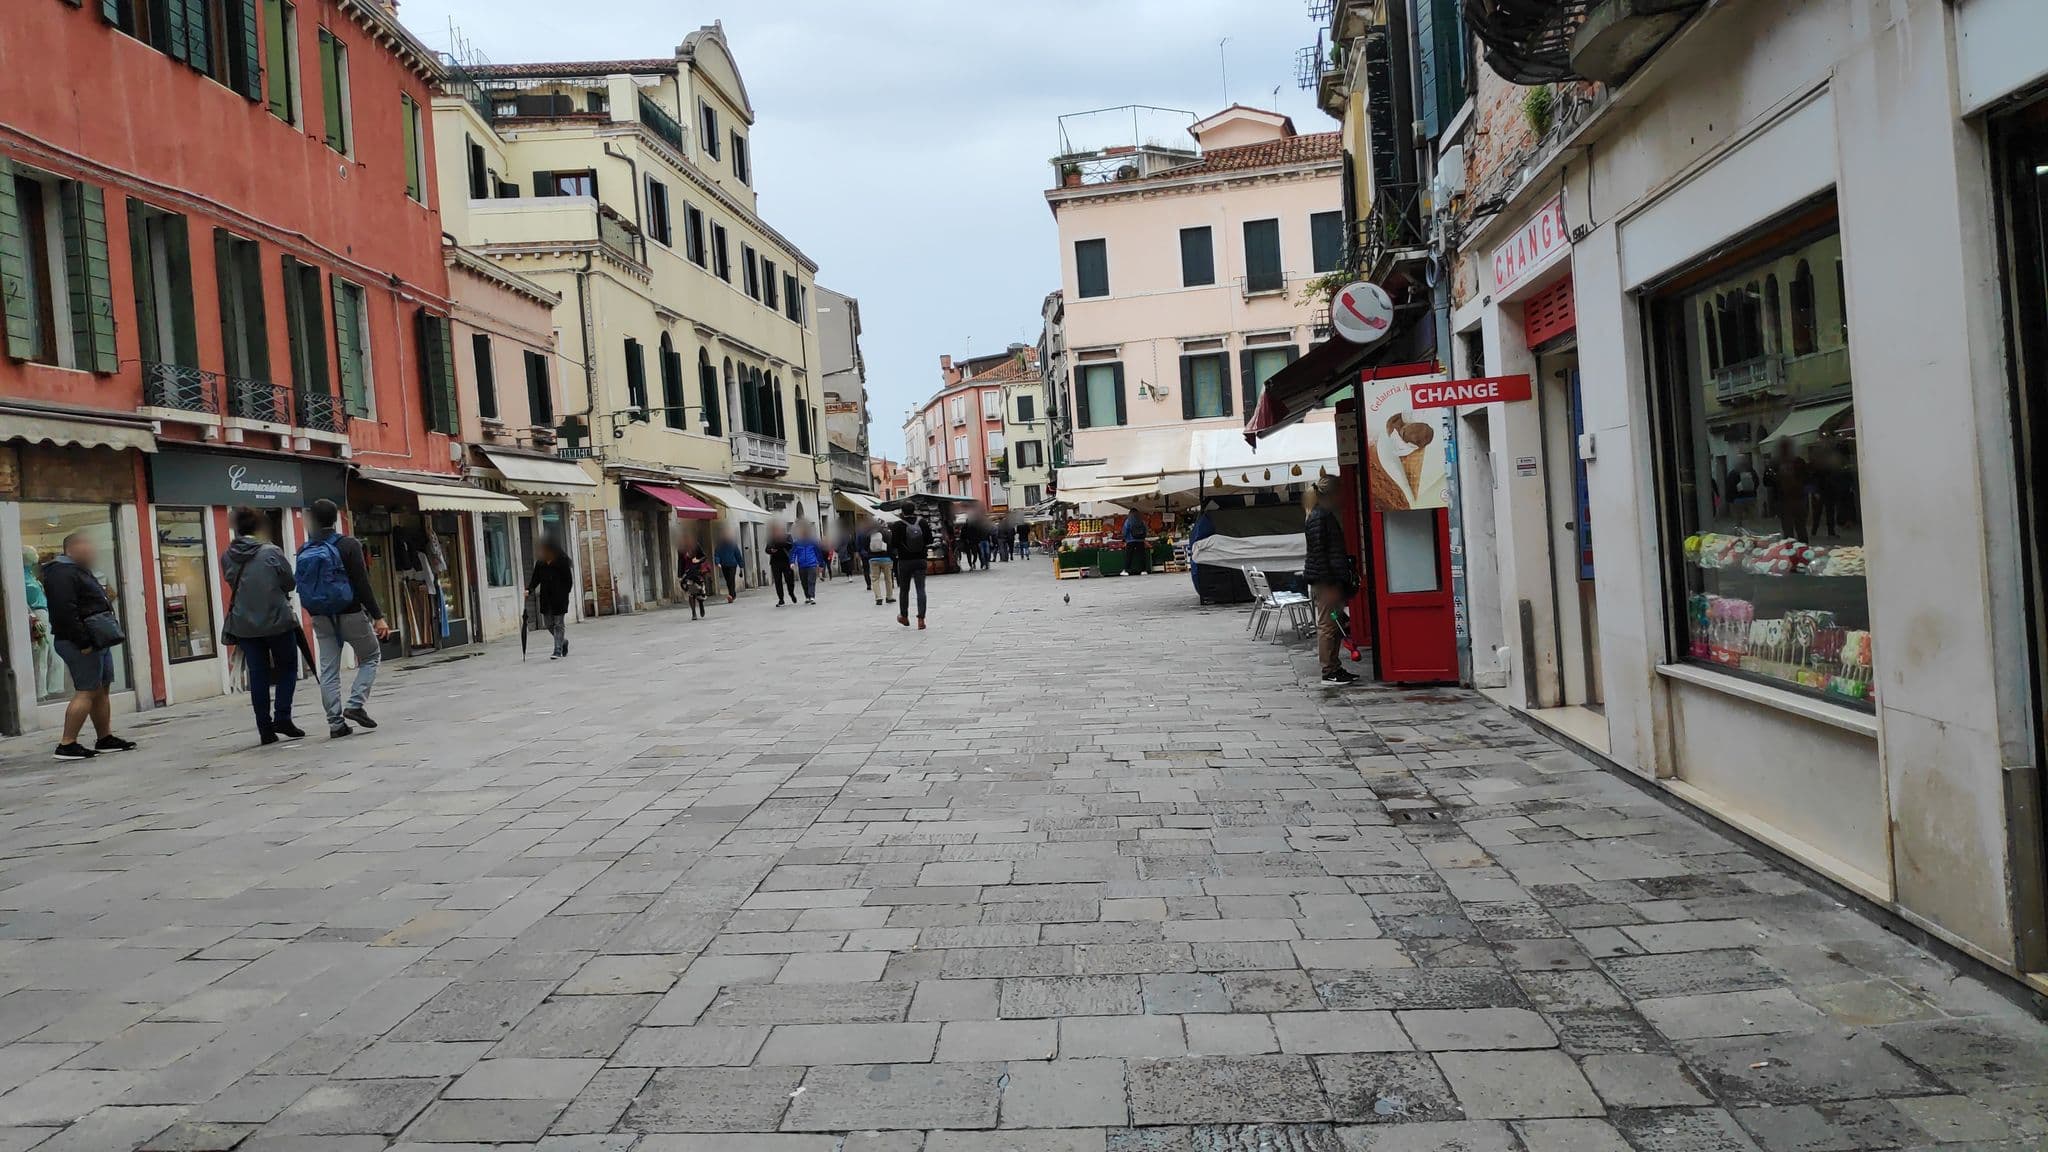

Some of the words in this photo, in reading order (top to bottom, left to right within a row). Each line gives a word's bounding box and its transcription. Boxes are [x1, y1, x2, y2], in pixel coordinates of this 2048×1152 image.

[1496, 204, 1565, 285] CHANGE
[1370, 385, 1401, 412] Gelateria
[1414, 382, 1499, 404] CHANGE
[560, 448, 590, 459] FARMACIA
[228, 465, 297, 493] Camicissima
